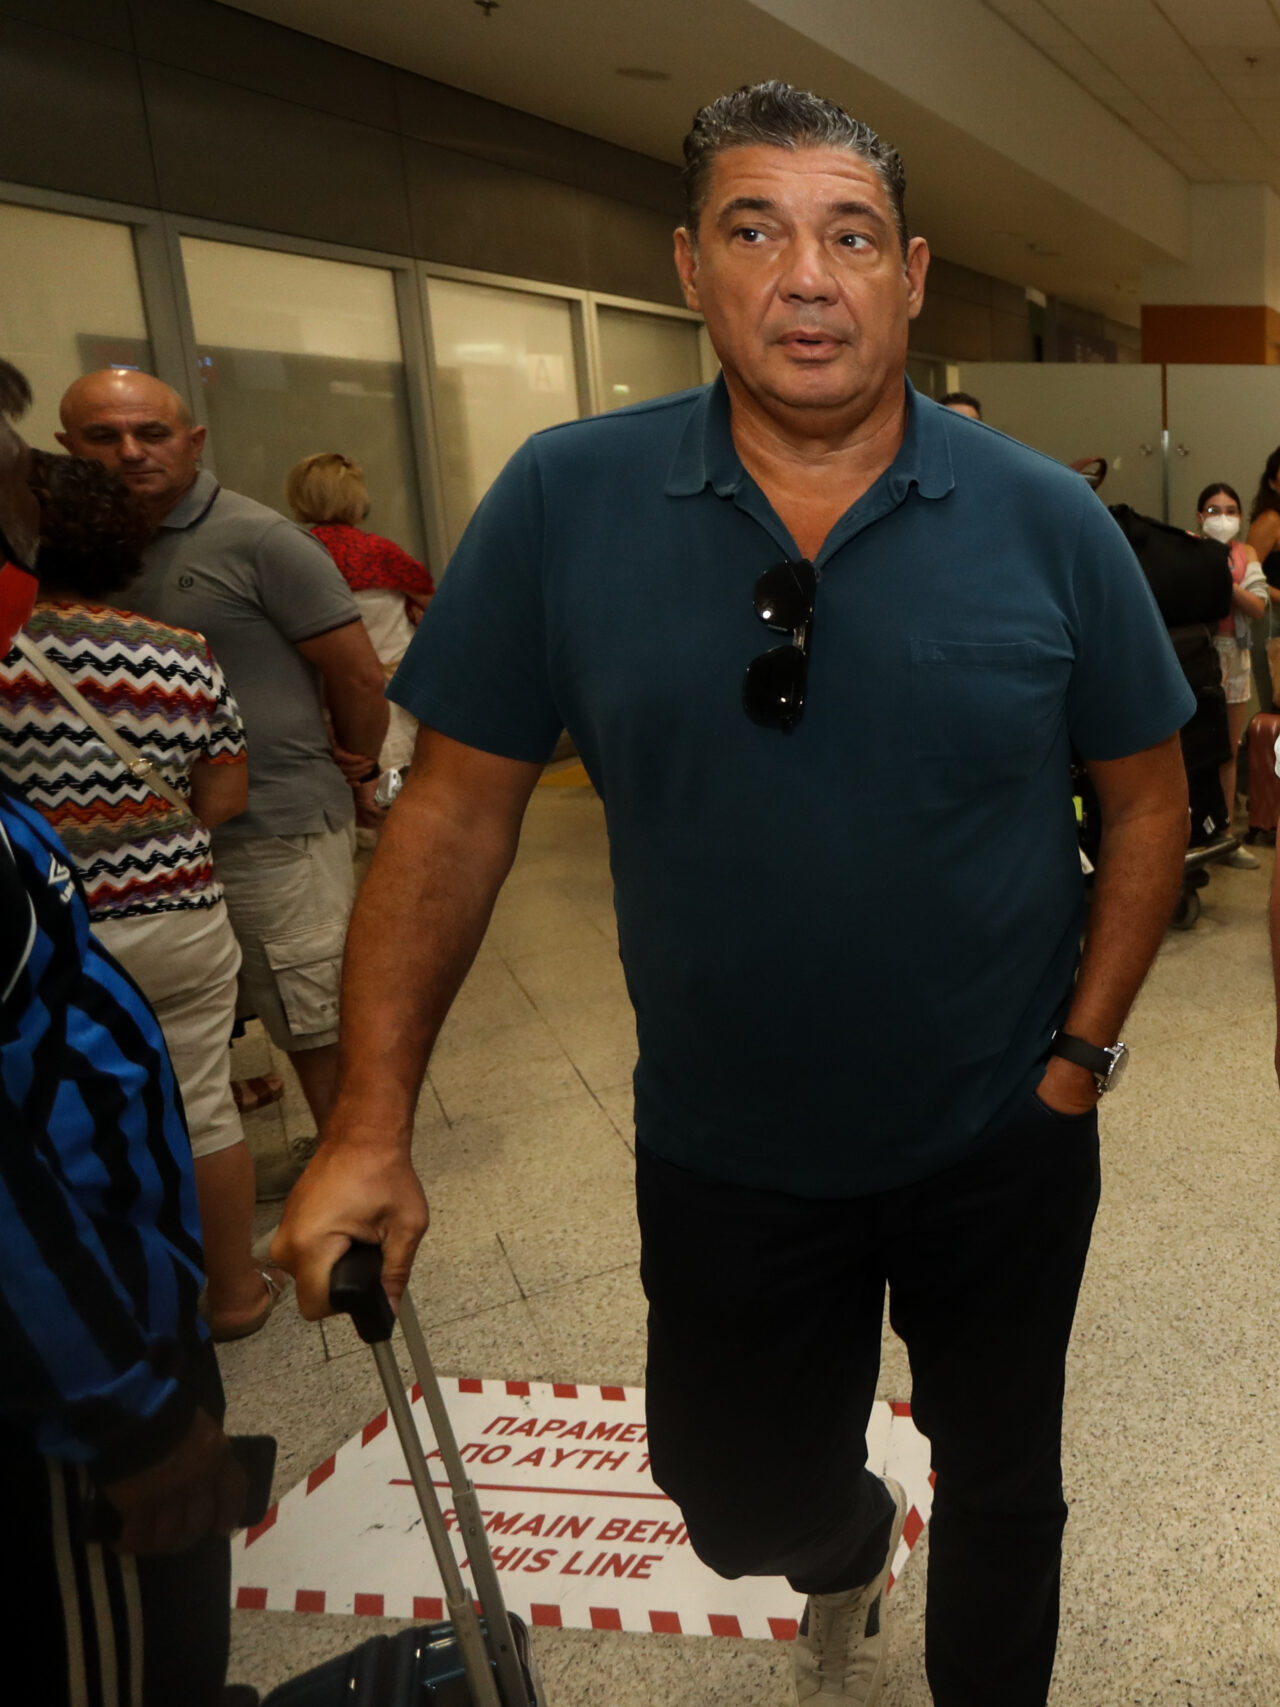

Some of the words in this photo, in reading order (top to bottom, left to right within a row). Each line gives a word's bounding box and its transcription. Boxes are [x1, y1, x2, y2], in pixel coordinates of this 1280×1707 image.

[512, 1447, 630, 1471] ΑΥΤΗ
[441, 1508, 594, 1540] RMAIN
[559, 1550, 664, 1579] LINE
